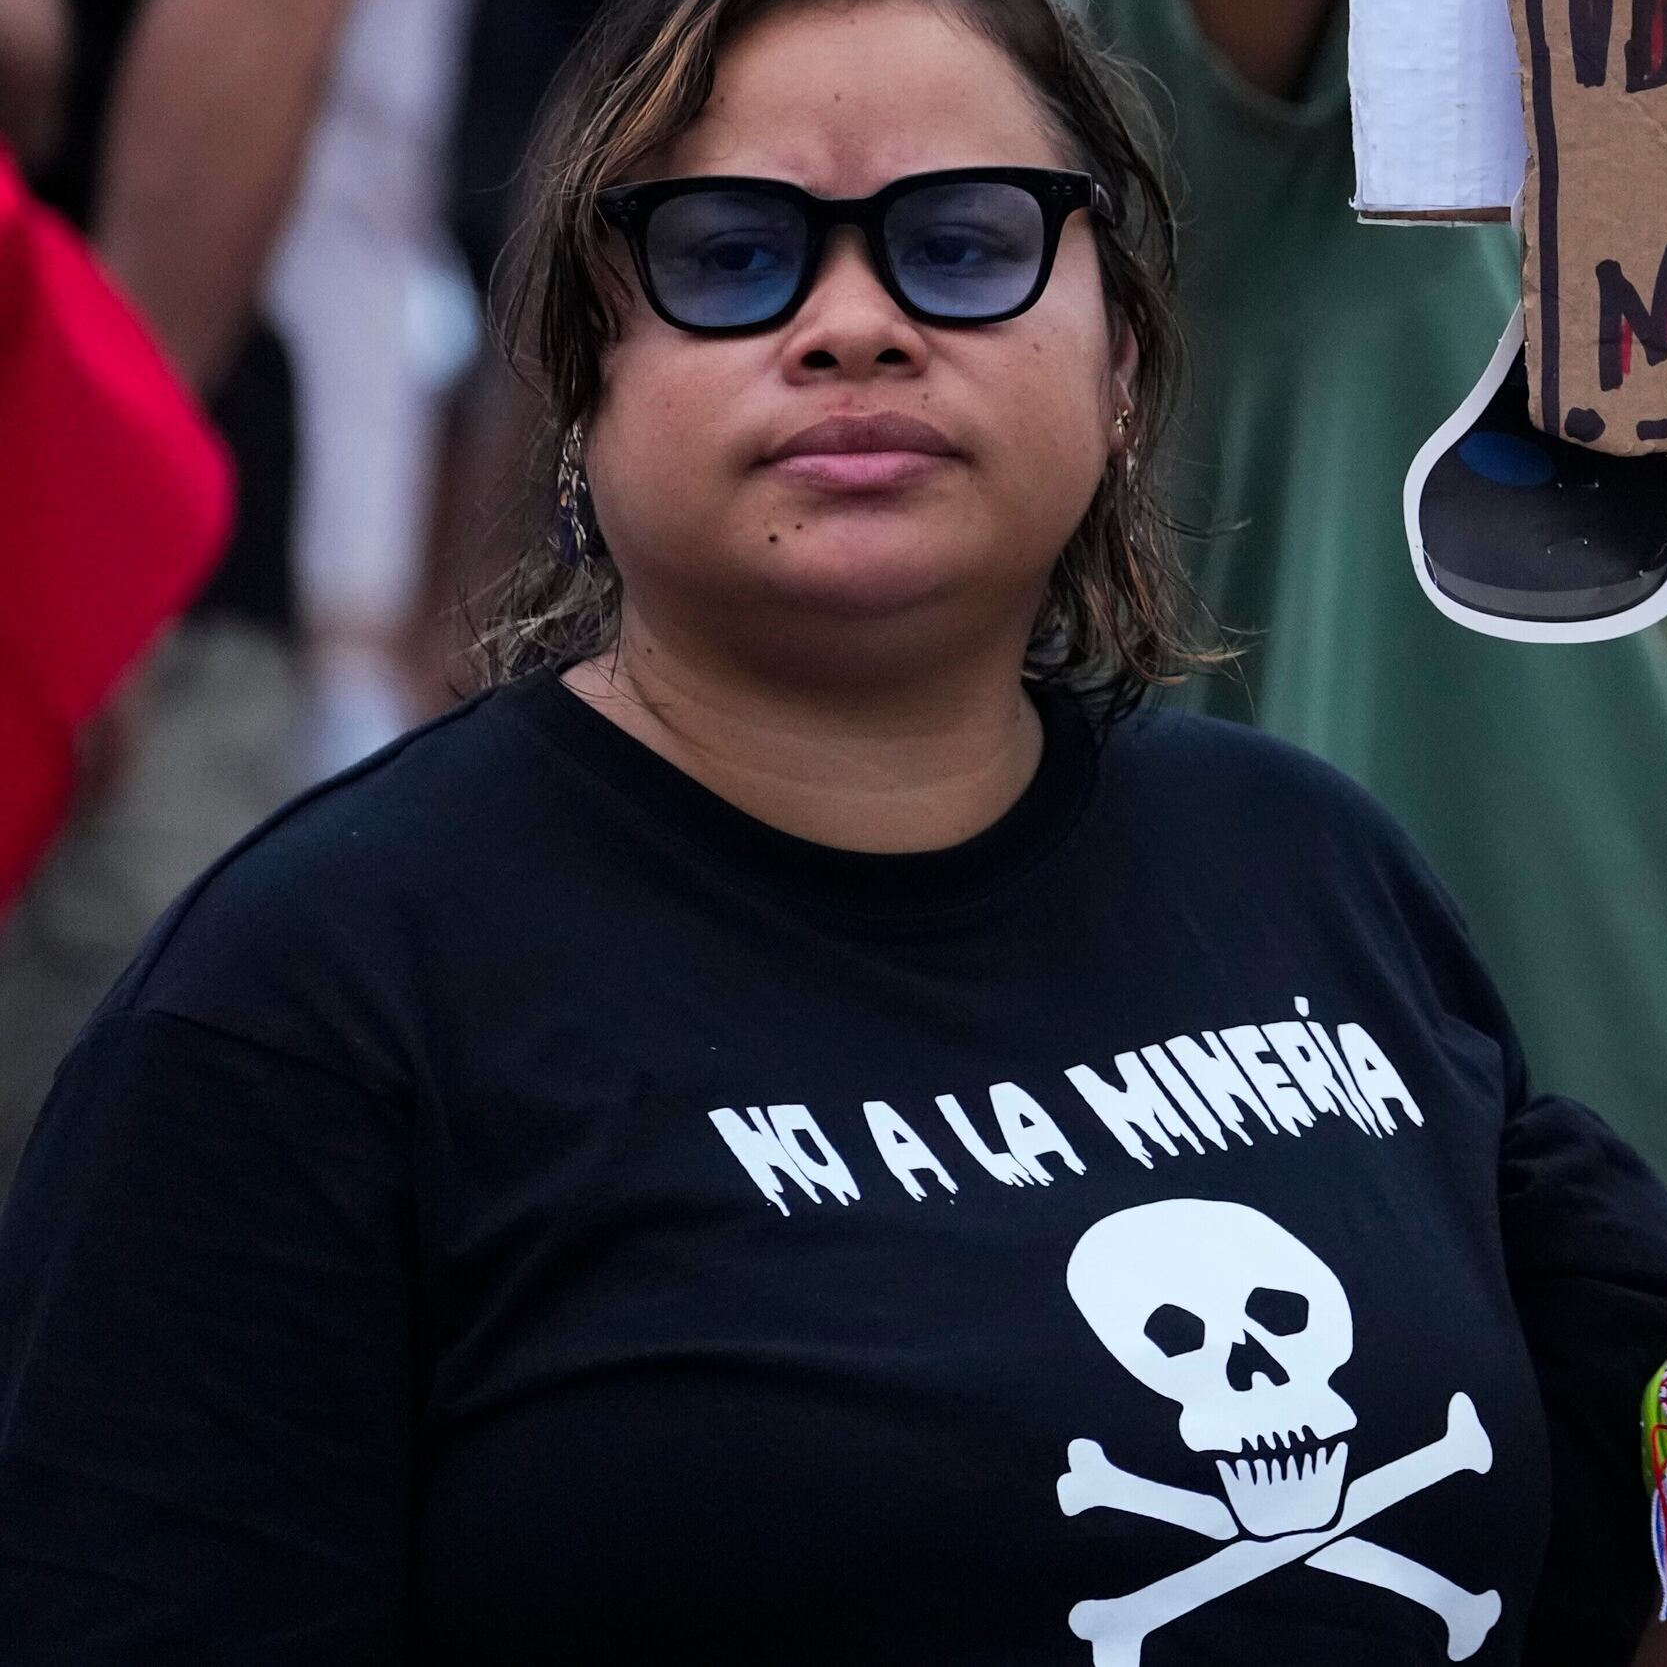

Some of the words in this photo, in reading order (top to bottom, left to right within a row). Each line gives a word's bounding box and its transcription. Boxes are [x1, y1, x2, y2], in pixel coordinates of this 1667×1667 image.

[708, 1105, 860, 1216] NO
[863, 1099, 962, 1201] A
[935, 1081, 1087, 1188] LA
[1064, 996, 1425, 1169] MINERÍA
